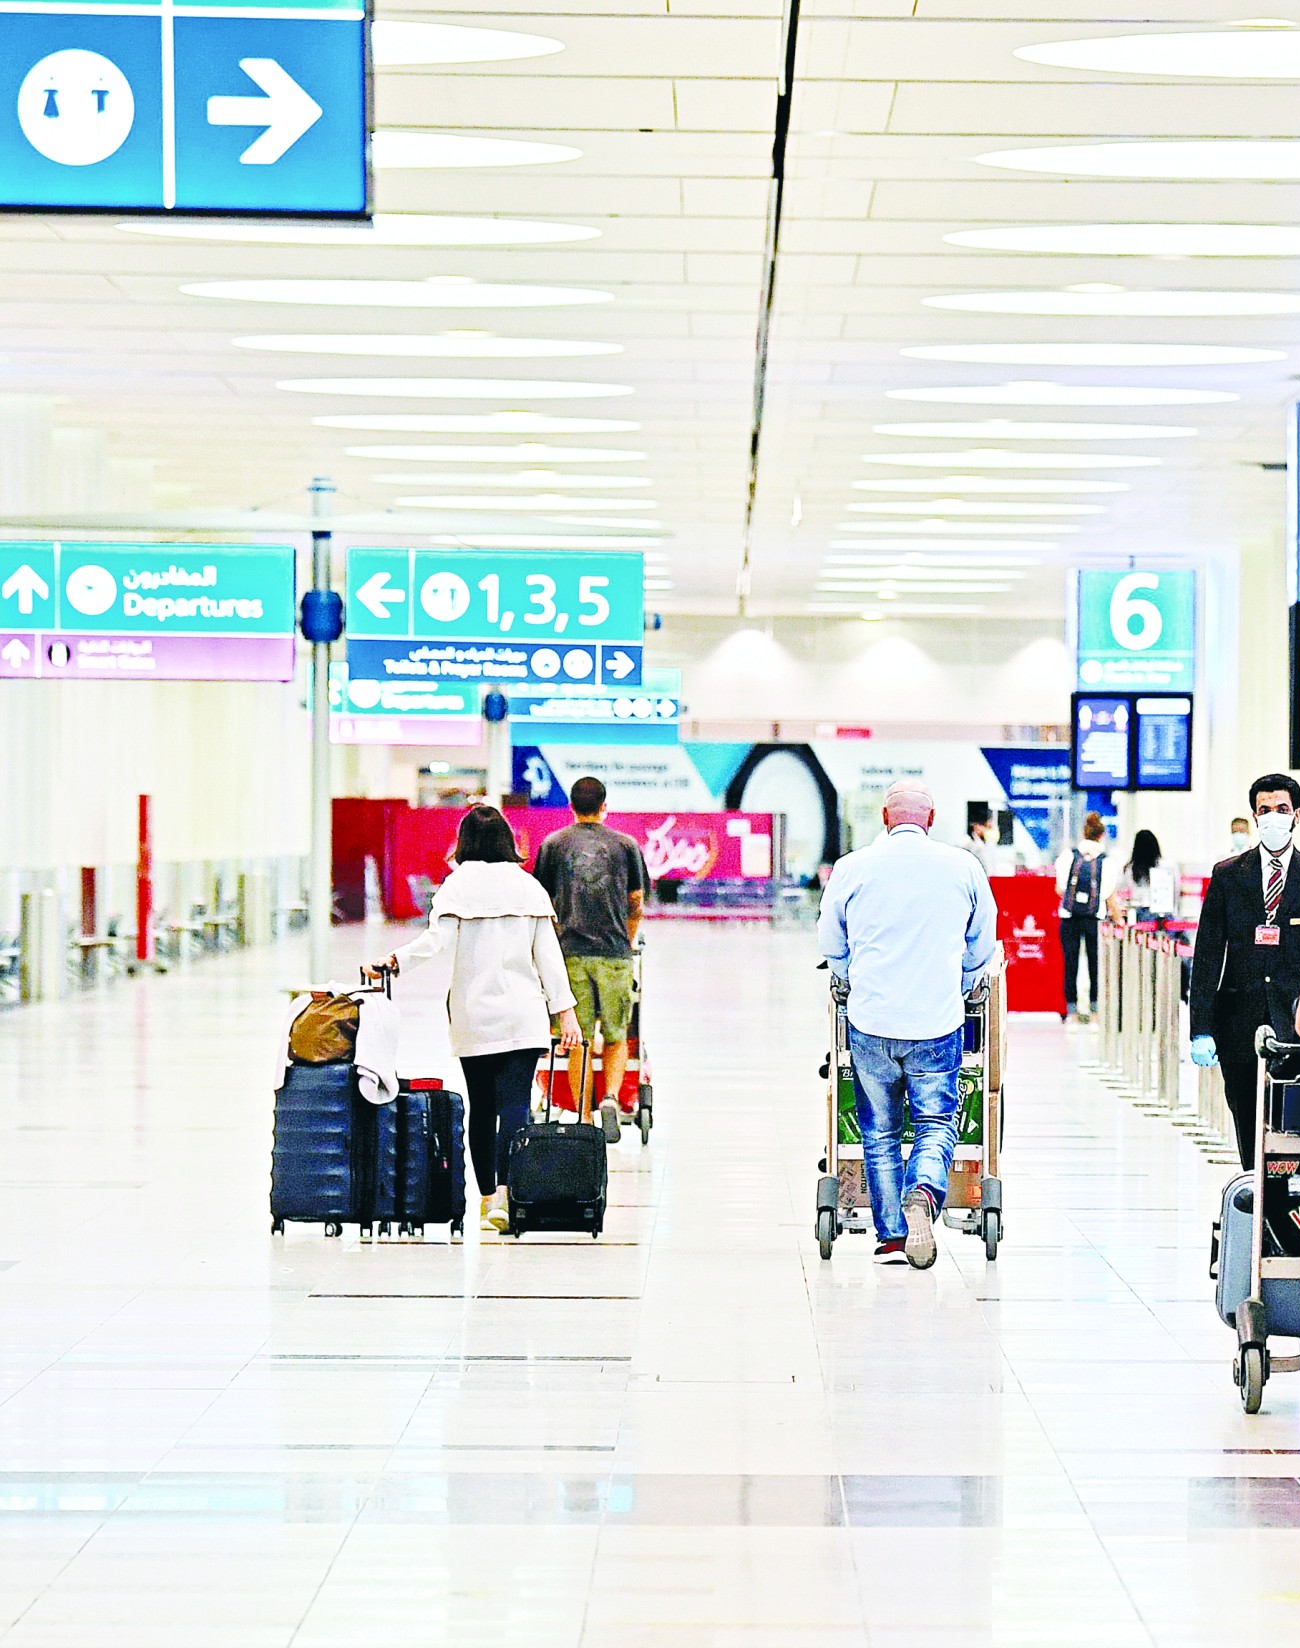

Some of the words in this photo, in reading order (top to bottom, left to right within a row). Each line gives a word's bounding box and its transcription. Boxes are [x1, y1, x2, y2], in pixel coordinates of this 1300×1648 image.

[122, 592, 264, 622] Departures
[1109, 571, 1163, 651] 6
[1266, 1160, 1300, 1175] WOW
